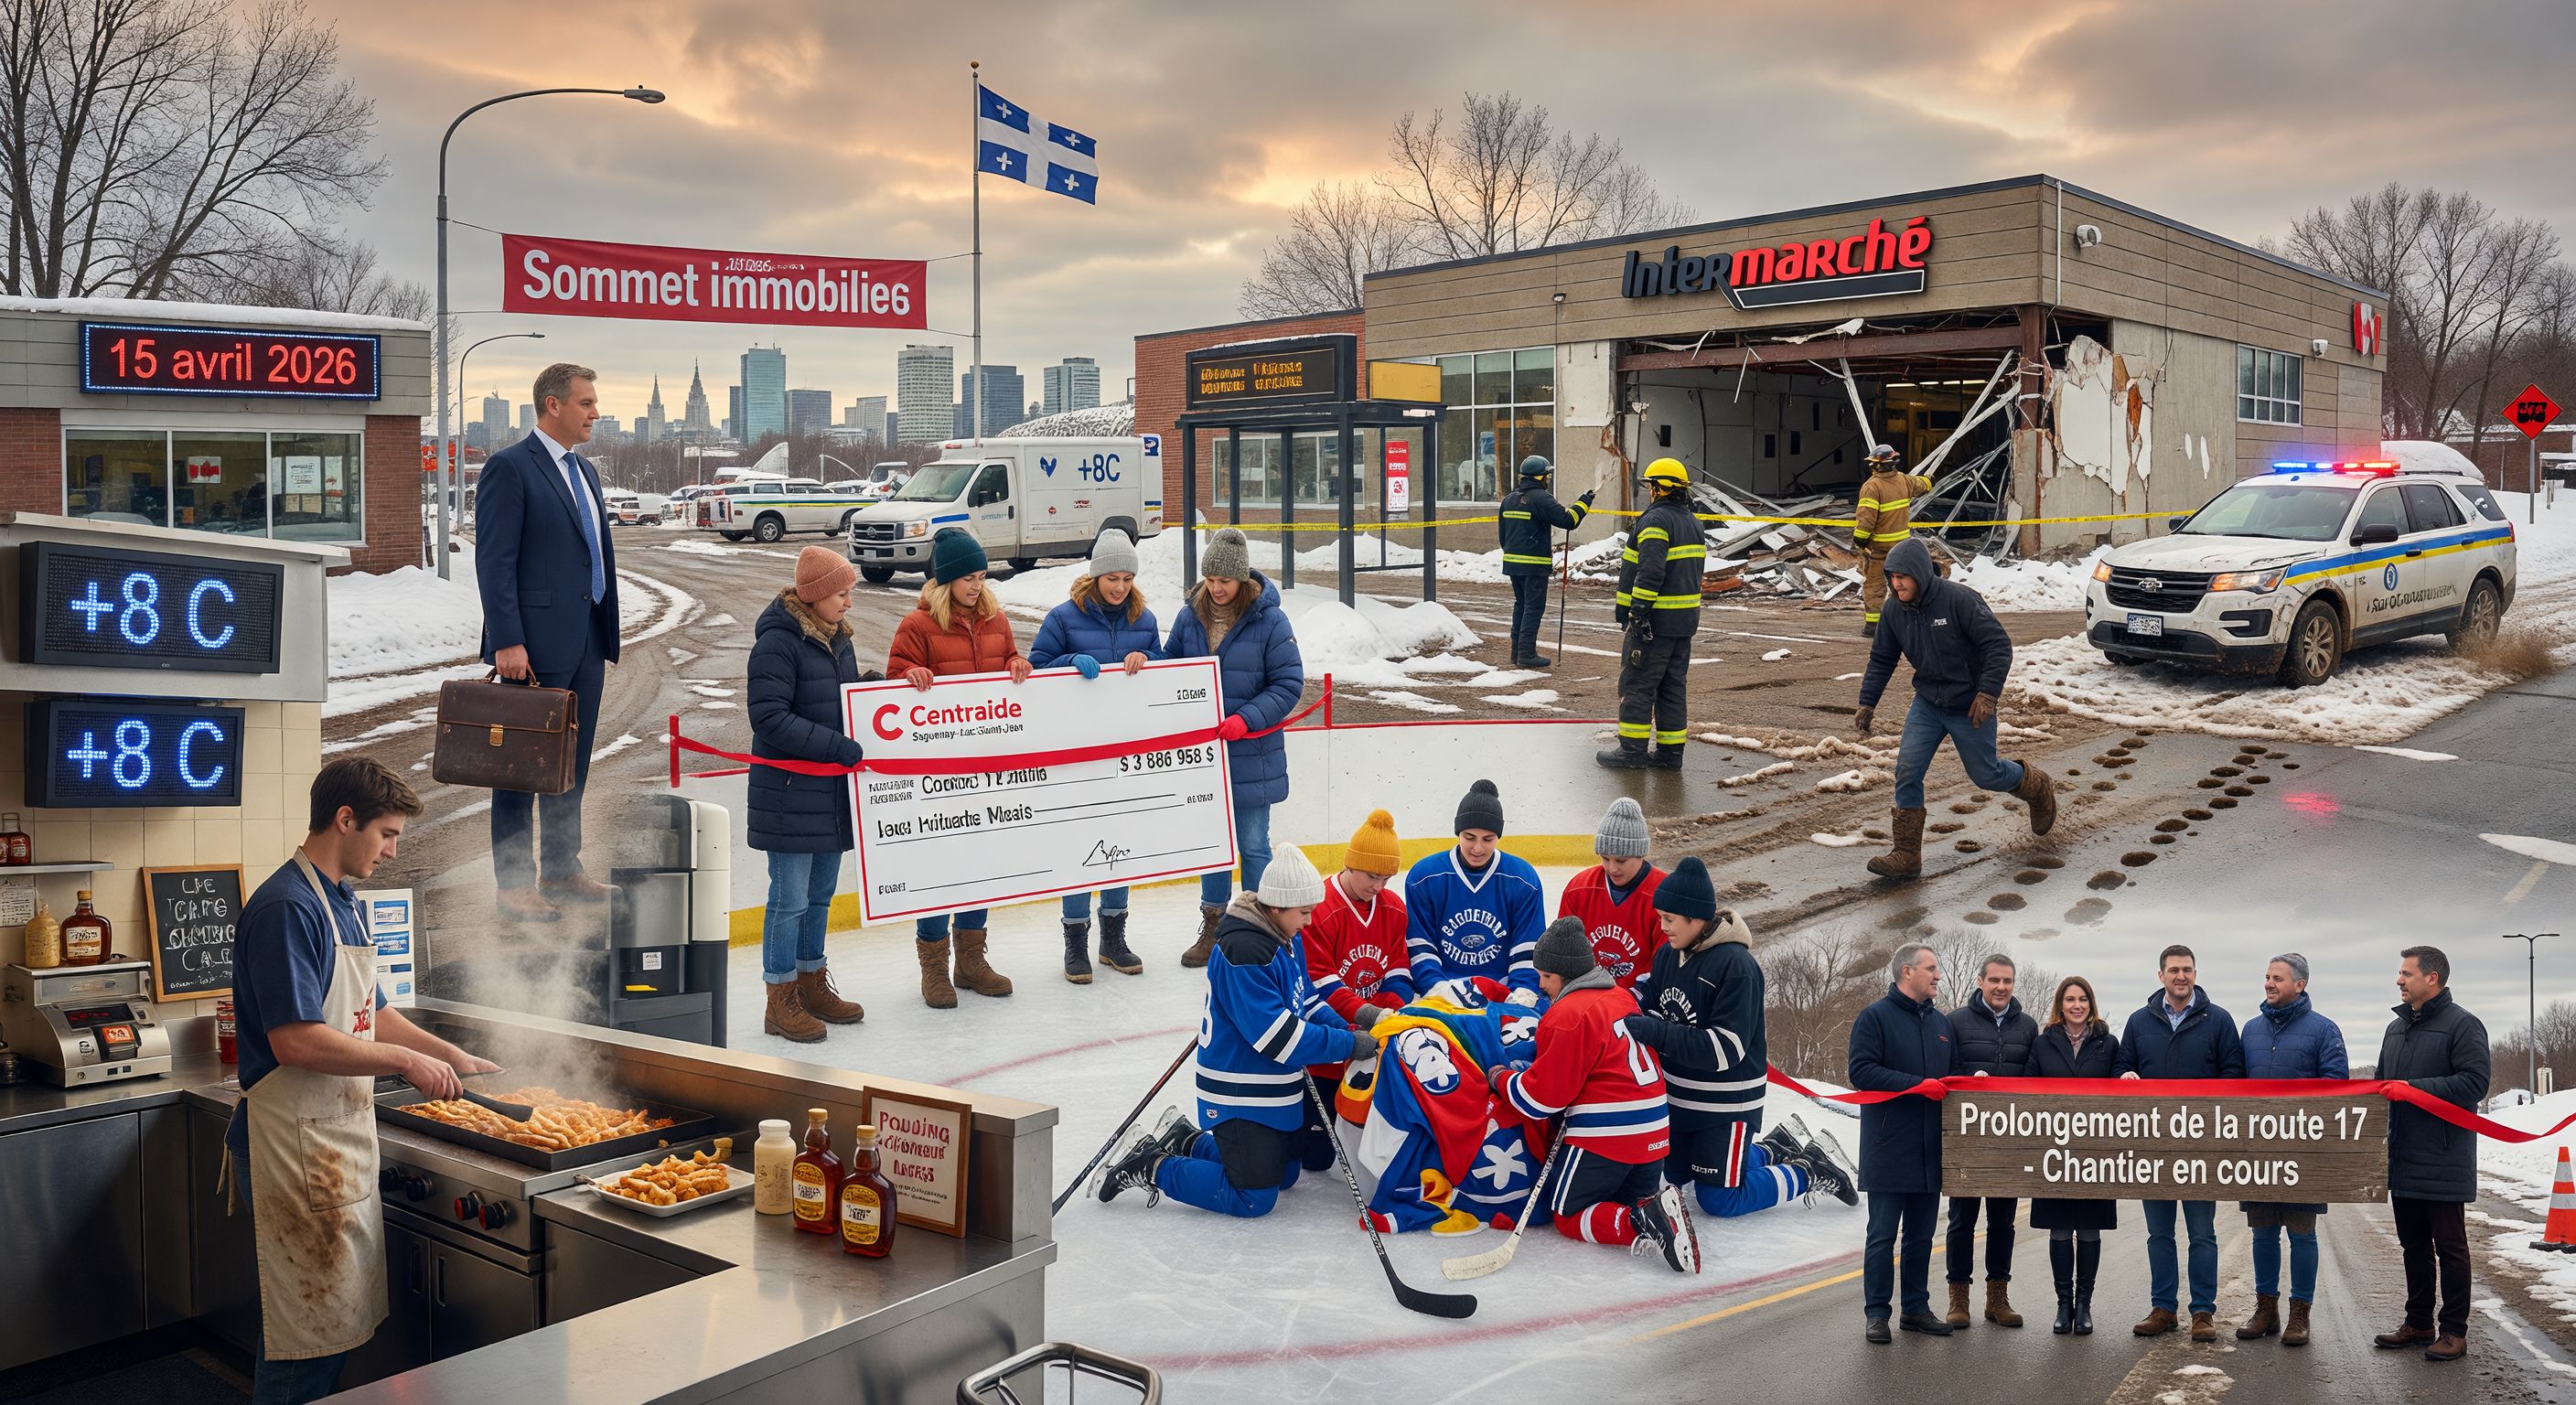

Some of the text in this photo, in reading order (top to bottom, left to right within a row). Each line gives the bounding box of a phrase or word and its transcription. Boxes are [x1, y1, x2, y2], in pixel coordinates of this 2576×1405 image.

[523, 249, 699, 306] Sommet
[1622, 217, 1932, 309] Intermarché
[111, 338, 357, 385] 15 avril 2026
[188, 579, 235, 649] C
[909, 698, 1022, 727] Centraide
[178, 721, 224, 788] C
[1960, 1102, 2368, 1146] Prolongement de la route 17
[2043, 1150, 2164, 1185] Chantier
[2172, 1159, 2207, 1185] en
[2216, 1159, 2300, 1186] cours
